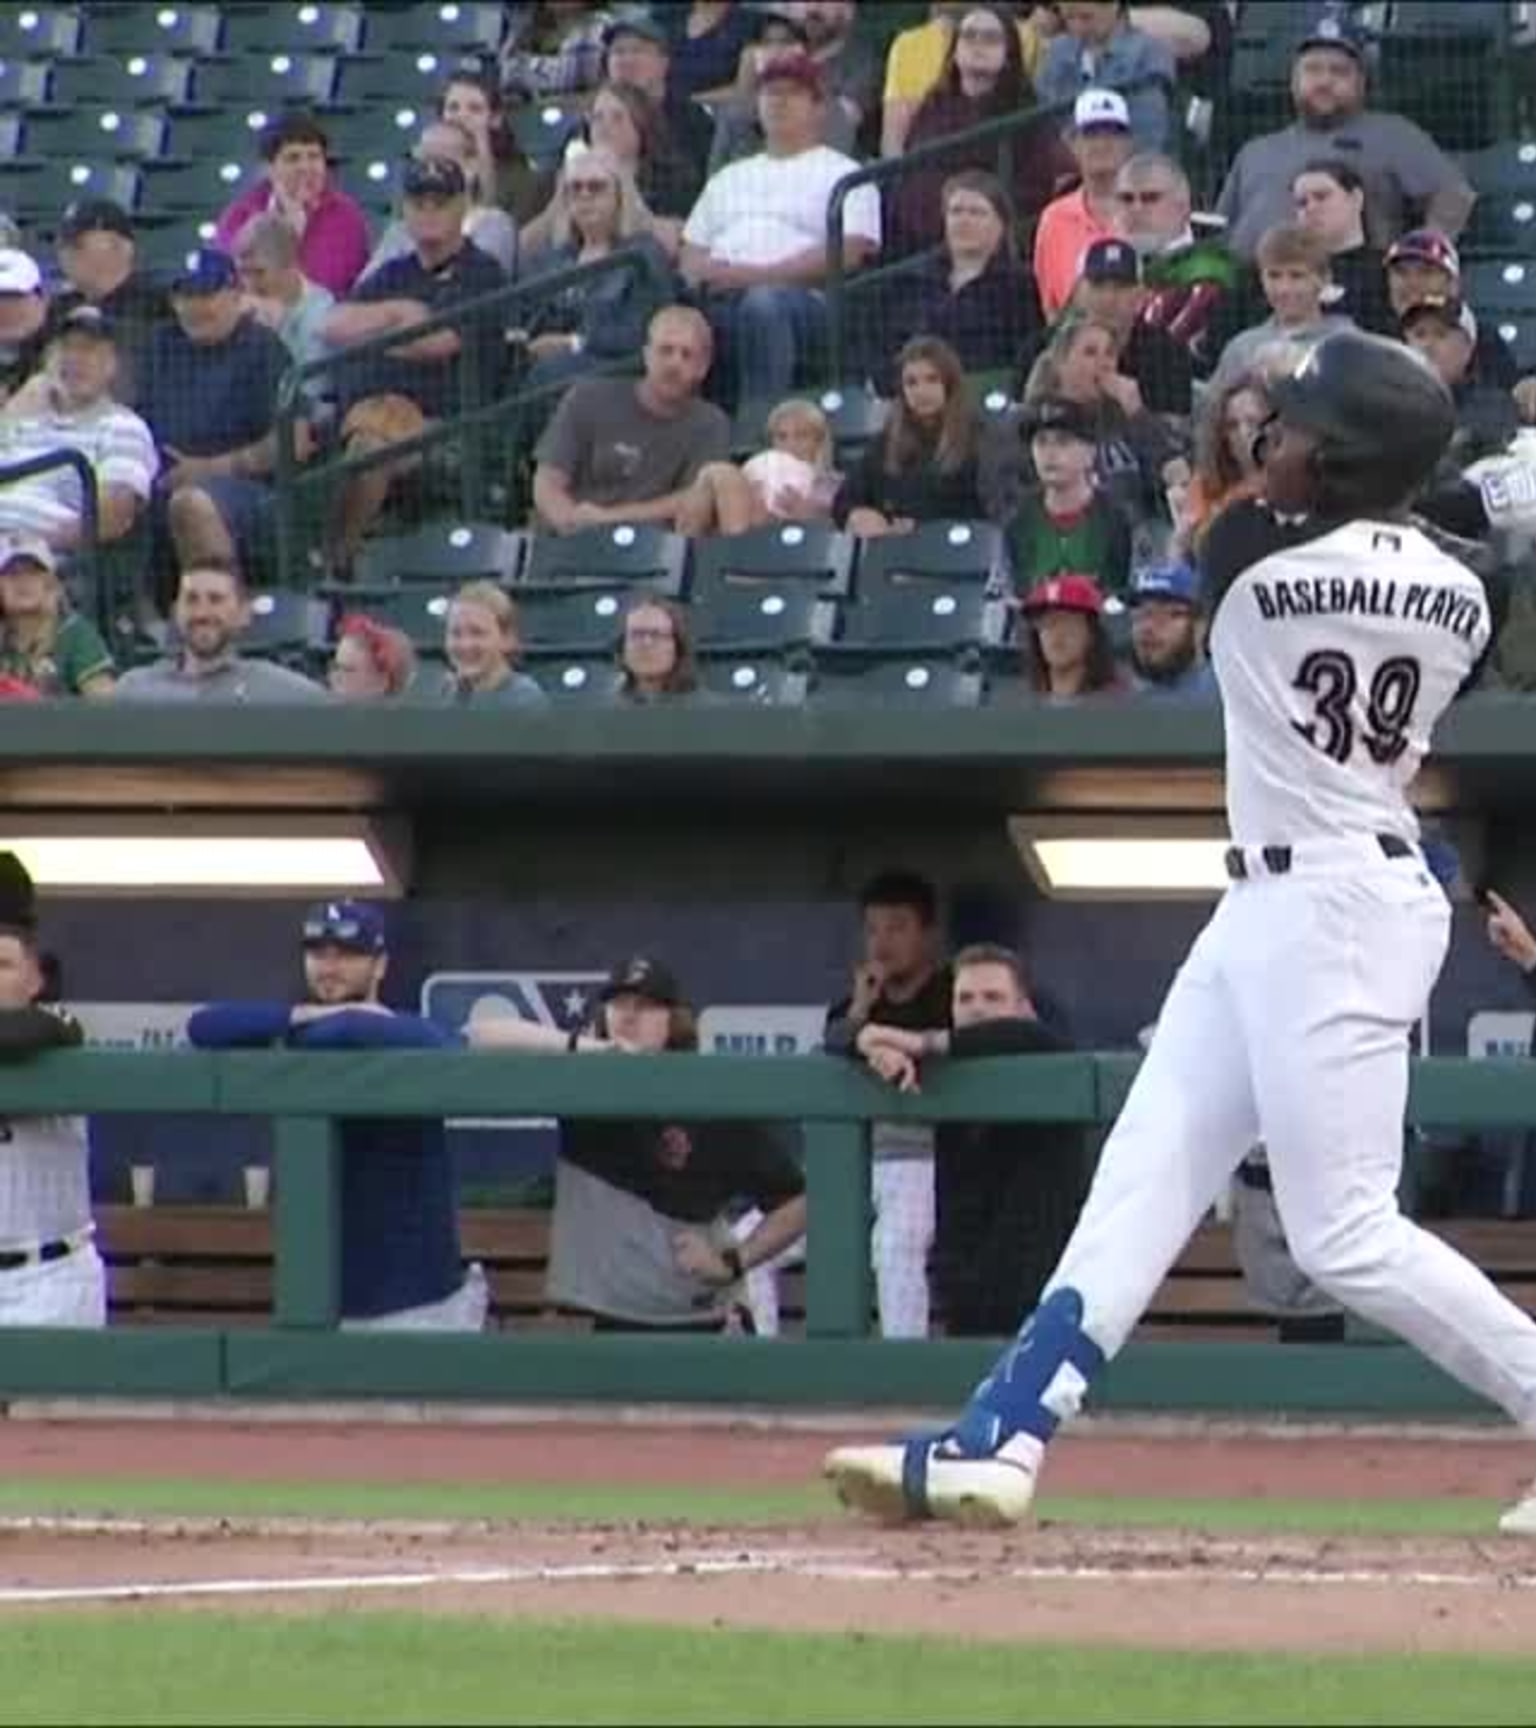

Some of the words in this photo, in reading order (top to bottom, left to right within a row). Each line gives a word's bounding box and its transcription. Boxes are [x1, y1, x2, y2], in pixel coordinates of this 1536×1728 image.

[1253, 577, 1397, 622] BASEBALL
[1402, 583, 1482, 641] PLAYER
[1290, 650, 1421, 765] 39
